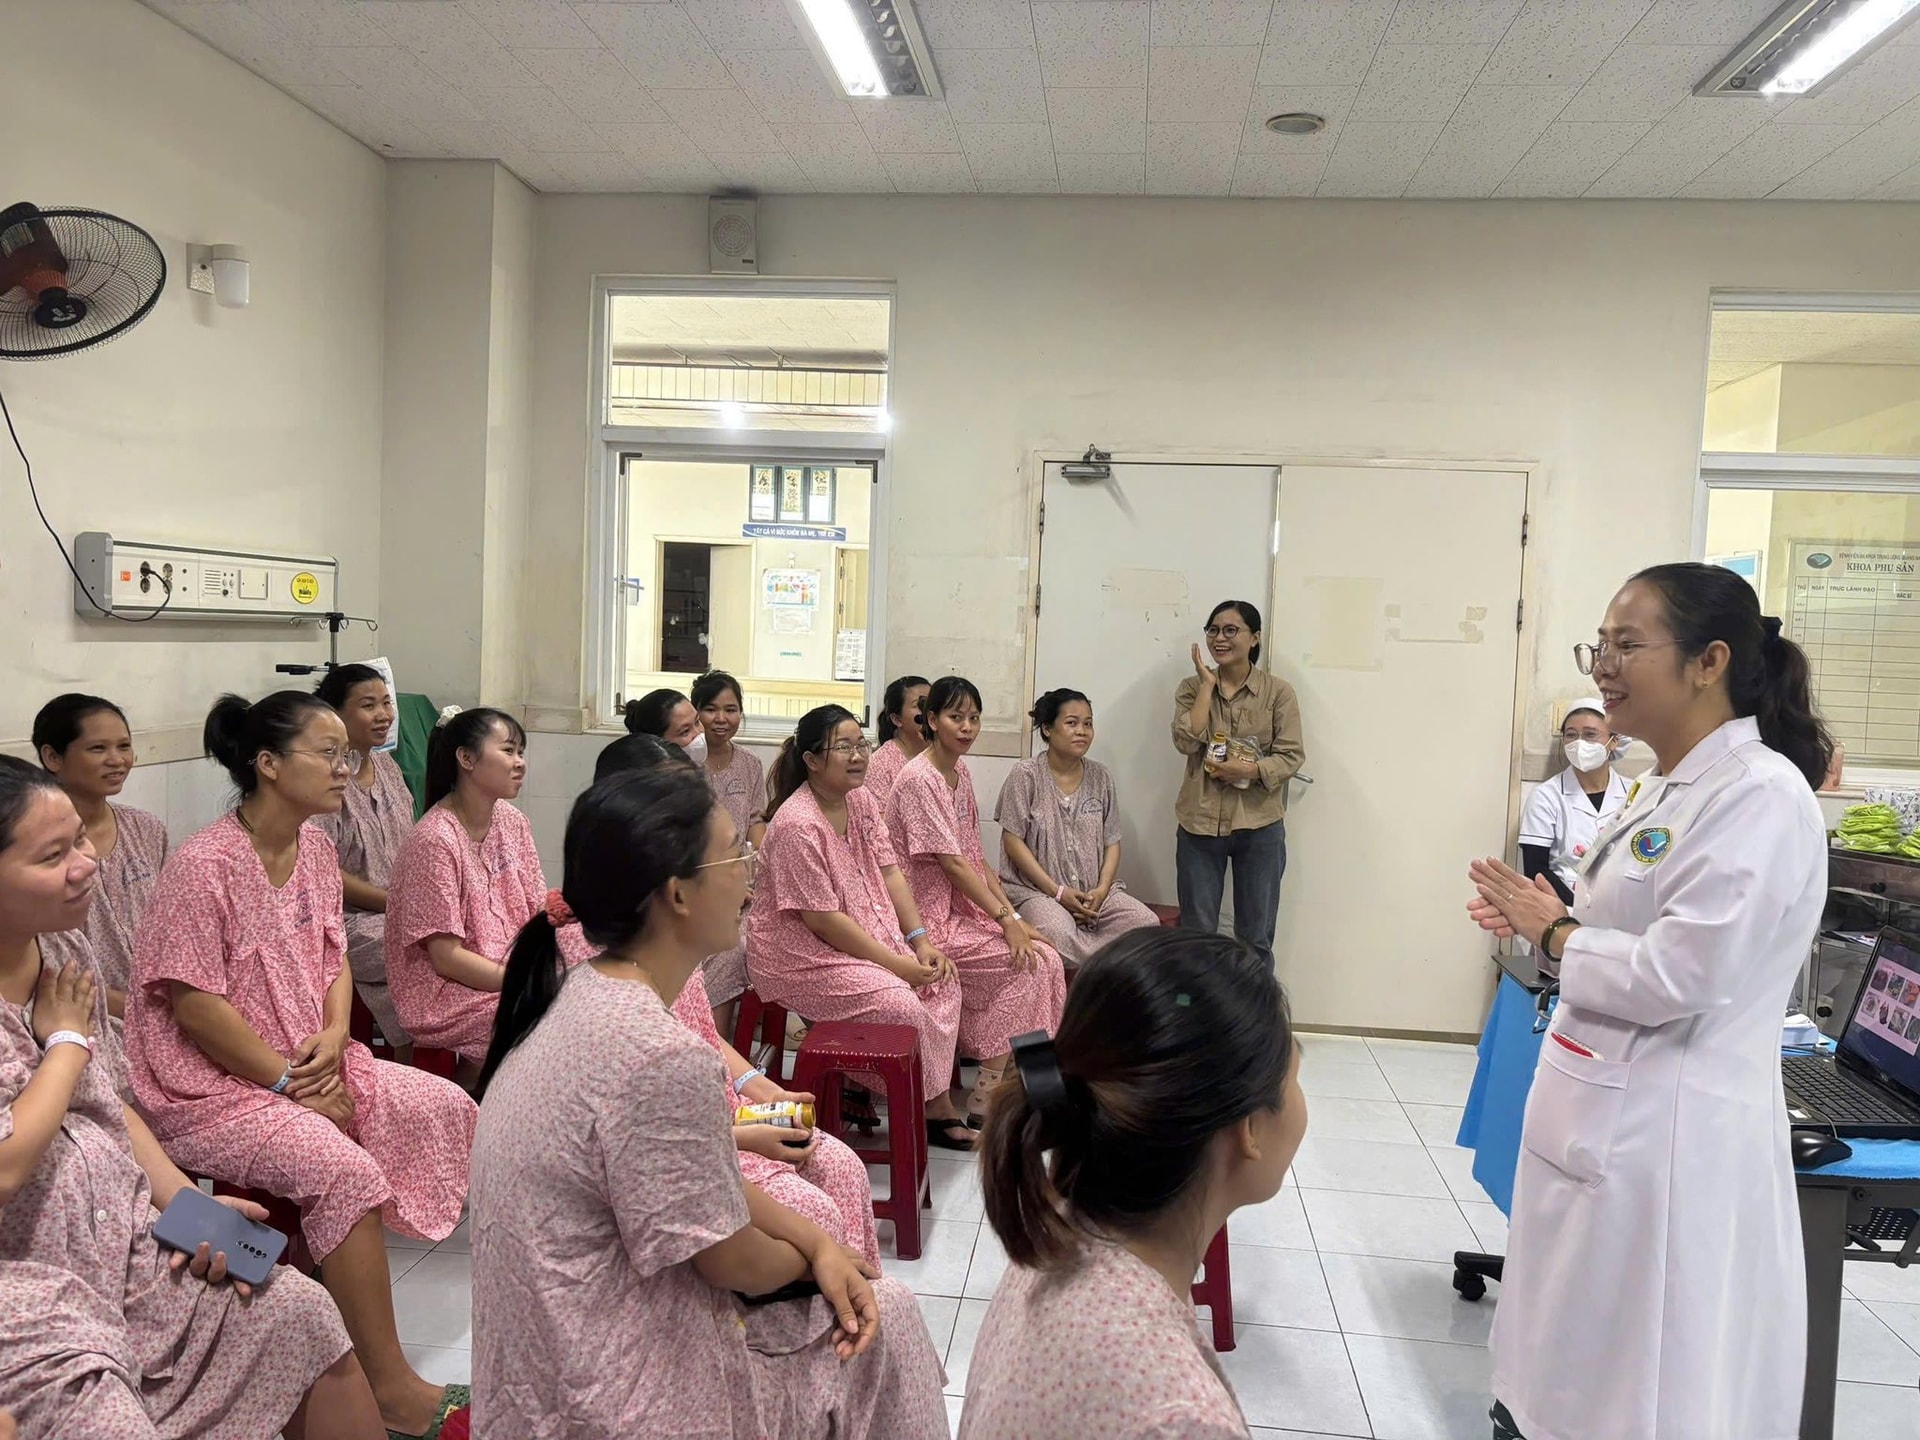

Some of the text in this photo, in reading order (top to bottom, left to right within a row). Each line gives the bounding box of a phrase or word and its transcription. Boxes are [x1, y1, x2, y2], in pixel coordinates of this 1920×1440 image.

[1846, 562, 1915, 574] KHOA PHỤ SẢN
